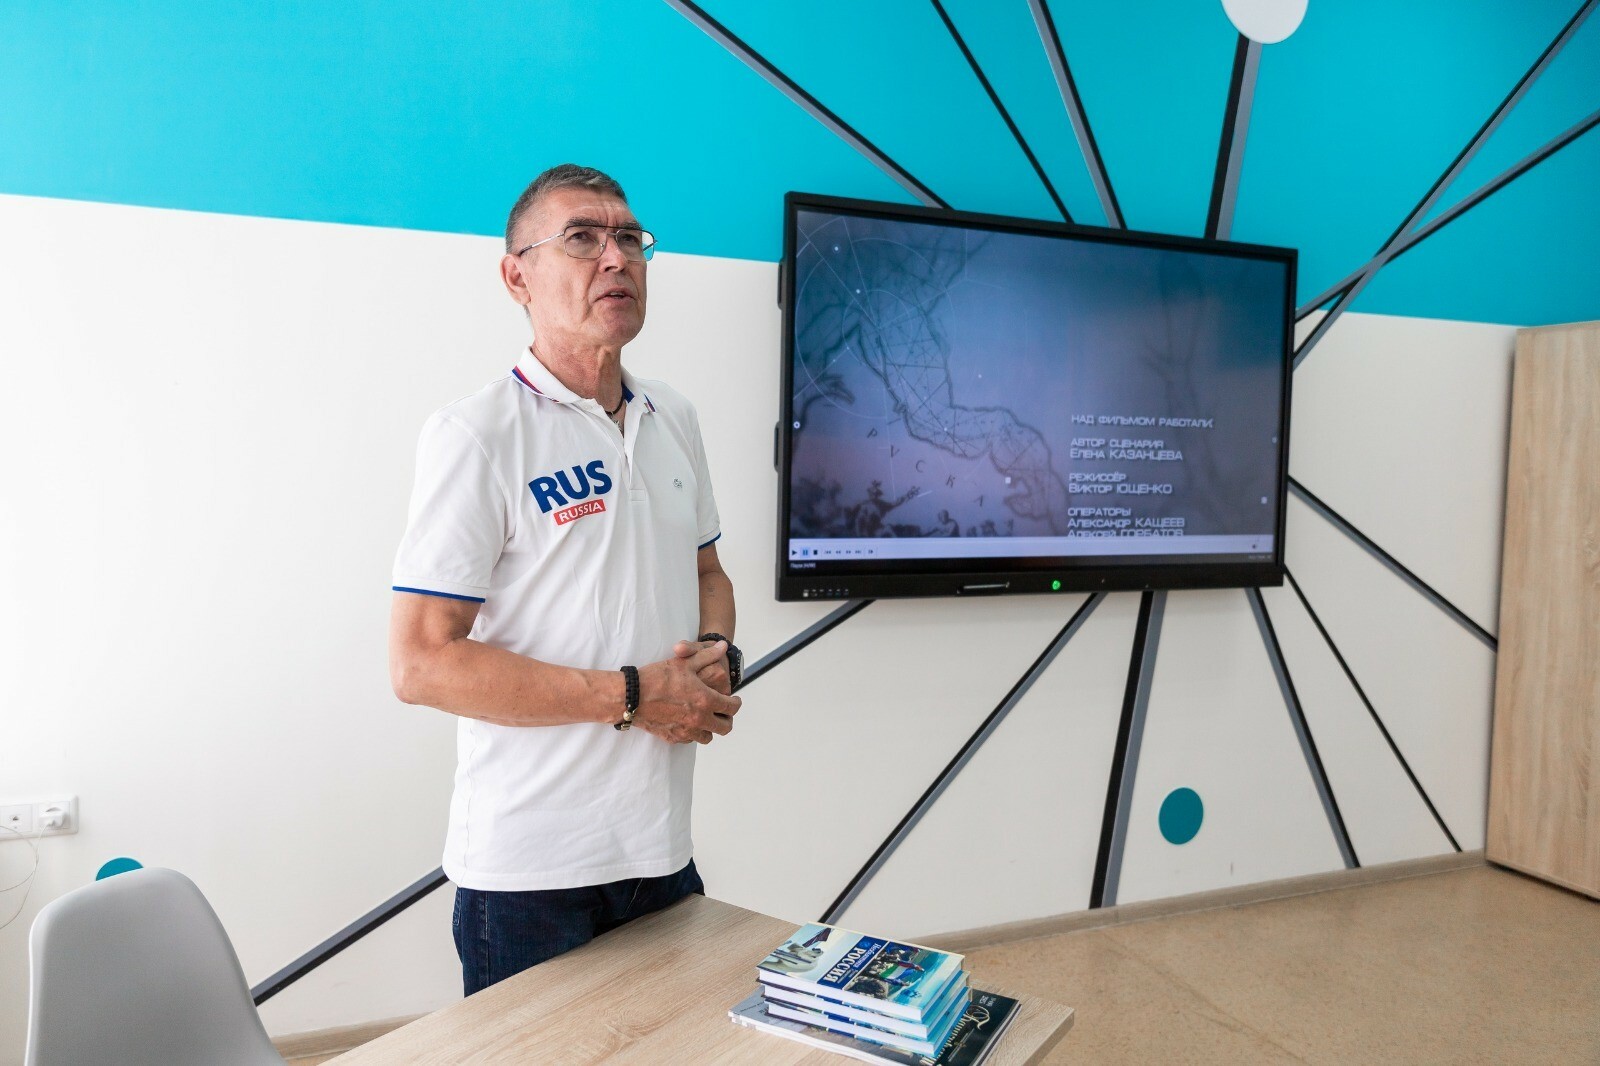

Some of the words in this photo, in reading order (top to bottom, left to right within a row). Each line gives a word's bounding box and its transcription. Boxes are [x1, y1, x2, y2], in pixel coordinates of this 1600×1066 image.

[1071, 415, 1094, 425] НАД
[1099, 416, 1155, 427] ФИЛЬМОМ
[1070, 438, 1105, 448] АВТОР
[1109, 439, 1164, 449] СЦЕНАРИЯ
[1070, 448, 1105, 459] ЕЛЕНА
[1109, 449, 1183, 461] КАЗАНЦЕВА
[1069, 471, 1126, 482] РЕЖИССЁР
[528, 460, 613, 514] RUS
[1068, 483, 1112, 494] ВИКТОР
[1116, 483, 1173, 495] ЮЩЕНКО
[558, 501, 604, 523] RUSSIA
[1067, 507, 1132, 517] ОПЕРАТОРЫ
[1067, 518, 1132, 528] АЛЕКСАНДР
[1135, 517, 1186, 528] КАЩЕЕВ
[823, 947, 867, 983] РОССИЯ
